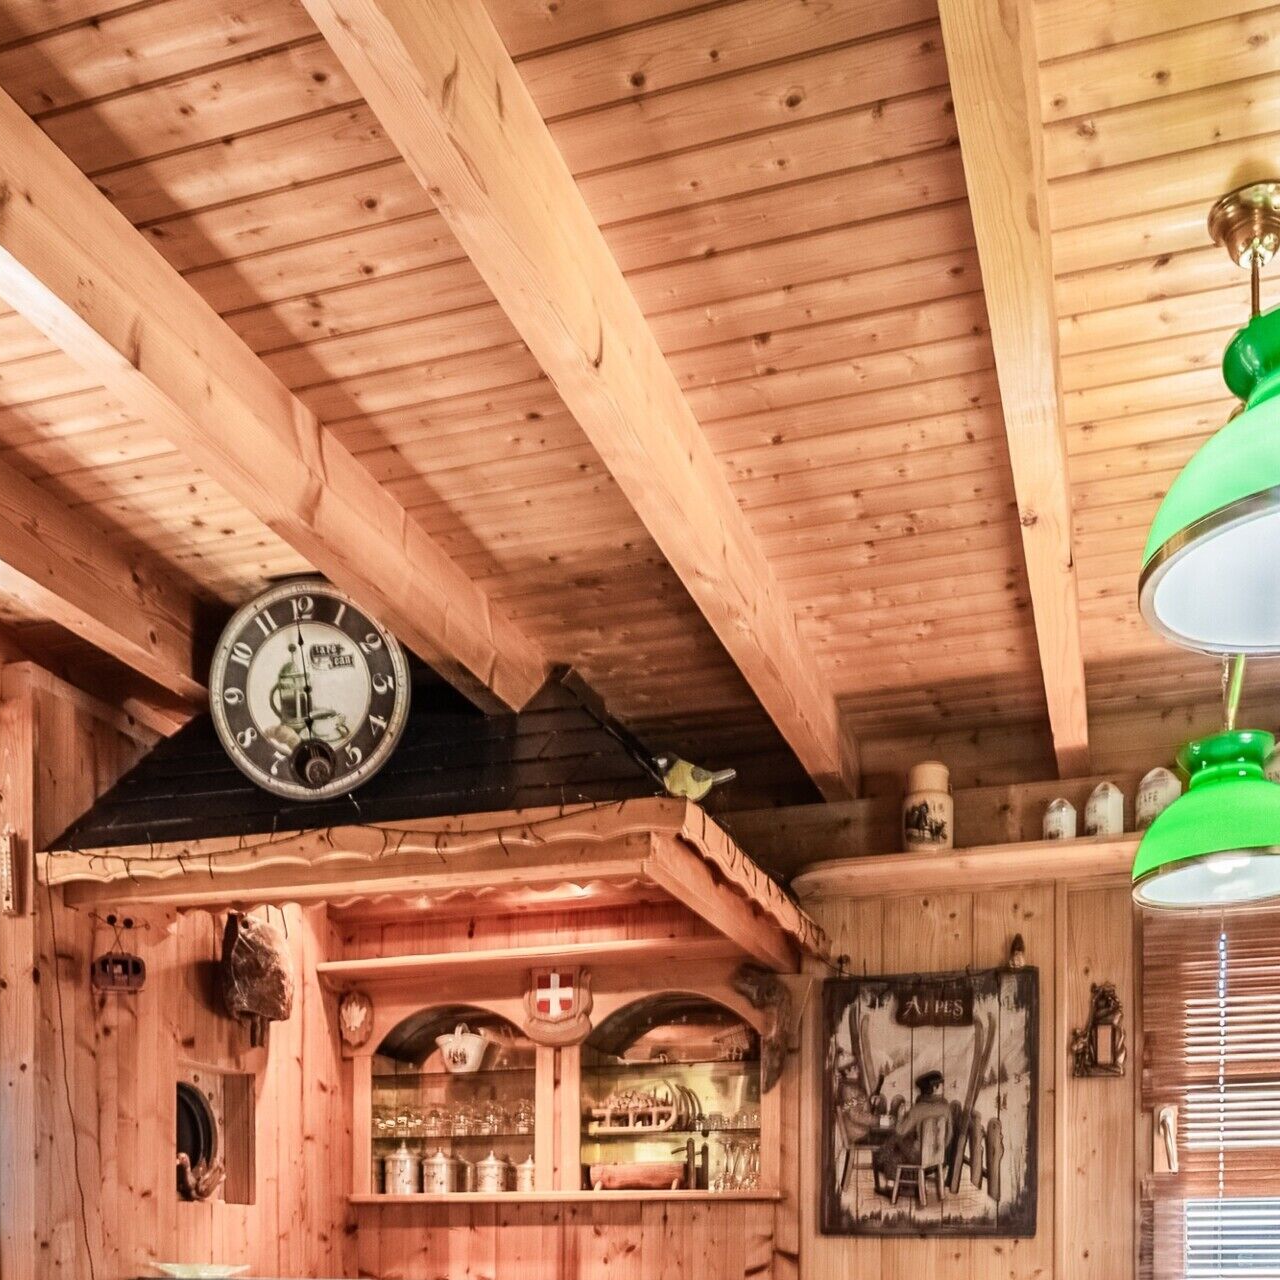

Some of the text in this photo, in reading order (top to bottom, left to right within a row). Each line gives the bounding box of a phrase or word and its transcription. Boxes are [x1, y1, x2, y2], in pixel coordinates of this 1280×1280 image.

[289, 595, 314, 620] 12
[333, 604, 346, 626] 1
[254, 608, 278, 636] 11
[230, 641, 254, 667] 10
[359, 632, 382, 655] 2
[372, 673, 395, 695] 3
[224, 687, 244, 706] 9
[368, 714, 388, 737] 4
[236, 726, 258, 749] 8
[270, 752, 287, 776] 7
[345, 744, 362, 768] 5
